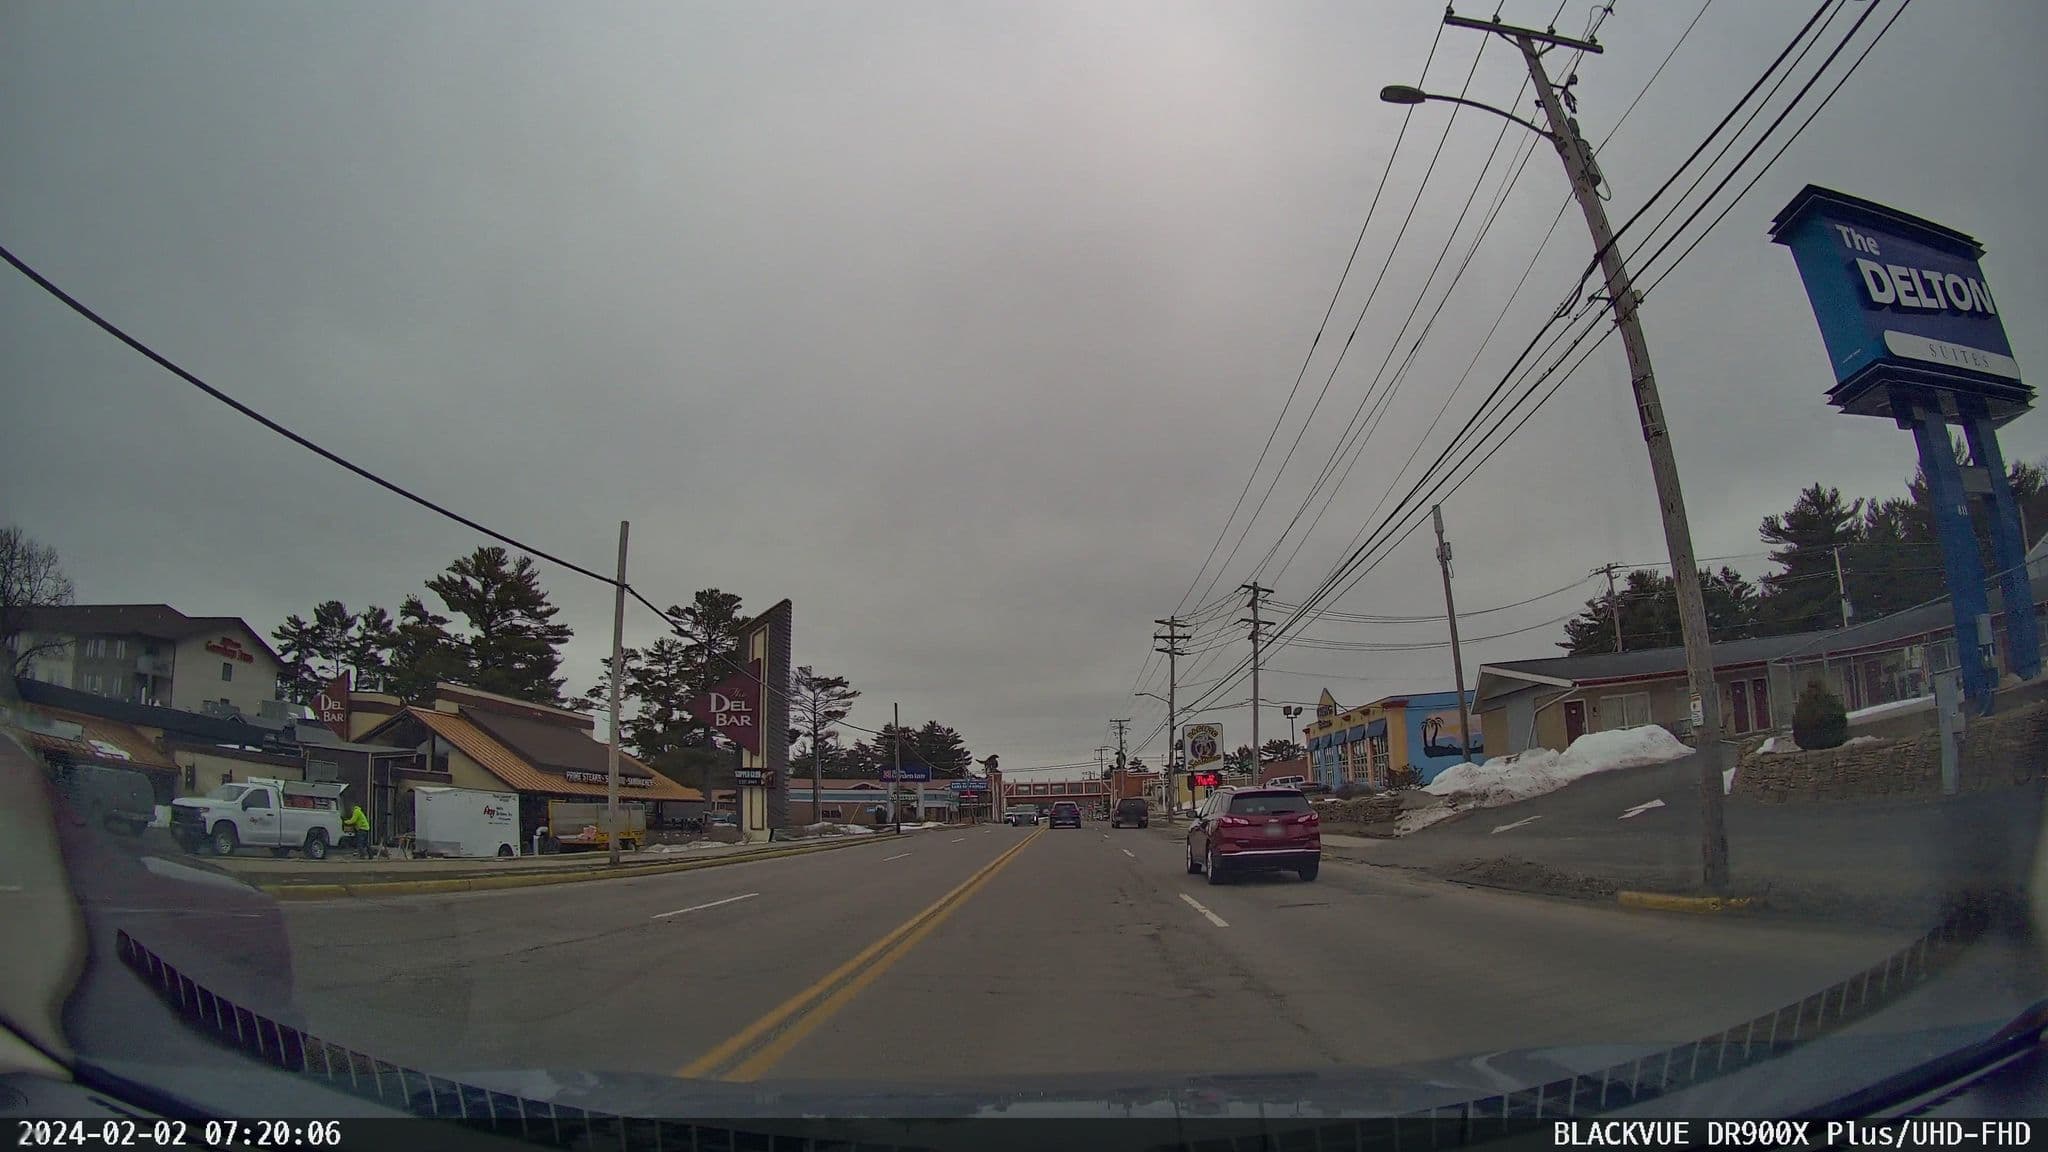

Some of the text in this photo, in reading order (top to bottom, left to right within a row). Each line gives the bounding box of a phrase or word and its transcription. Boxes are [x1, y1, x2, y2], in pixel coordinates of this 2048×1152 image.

[1835, 224, 1880, 256] The
[1856, 257, 1997, 316] DELTON
[1928, 343, 1991, 369] SUITES
[729, 687, 746, 698] The
[320, 694, 345, 711] DEL
[708, 692, 753, 713] DEL
[323, 711, 345, 723] BAR
[715, 713, 753, 727] BAR
